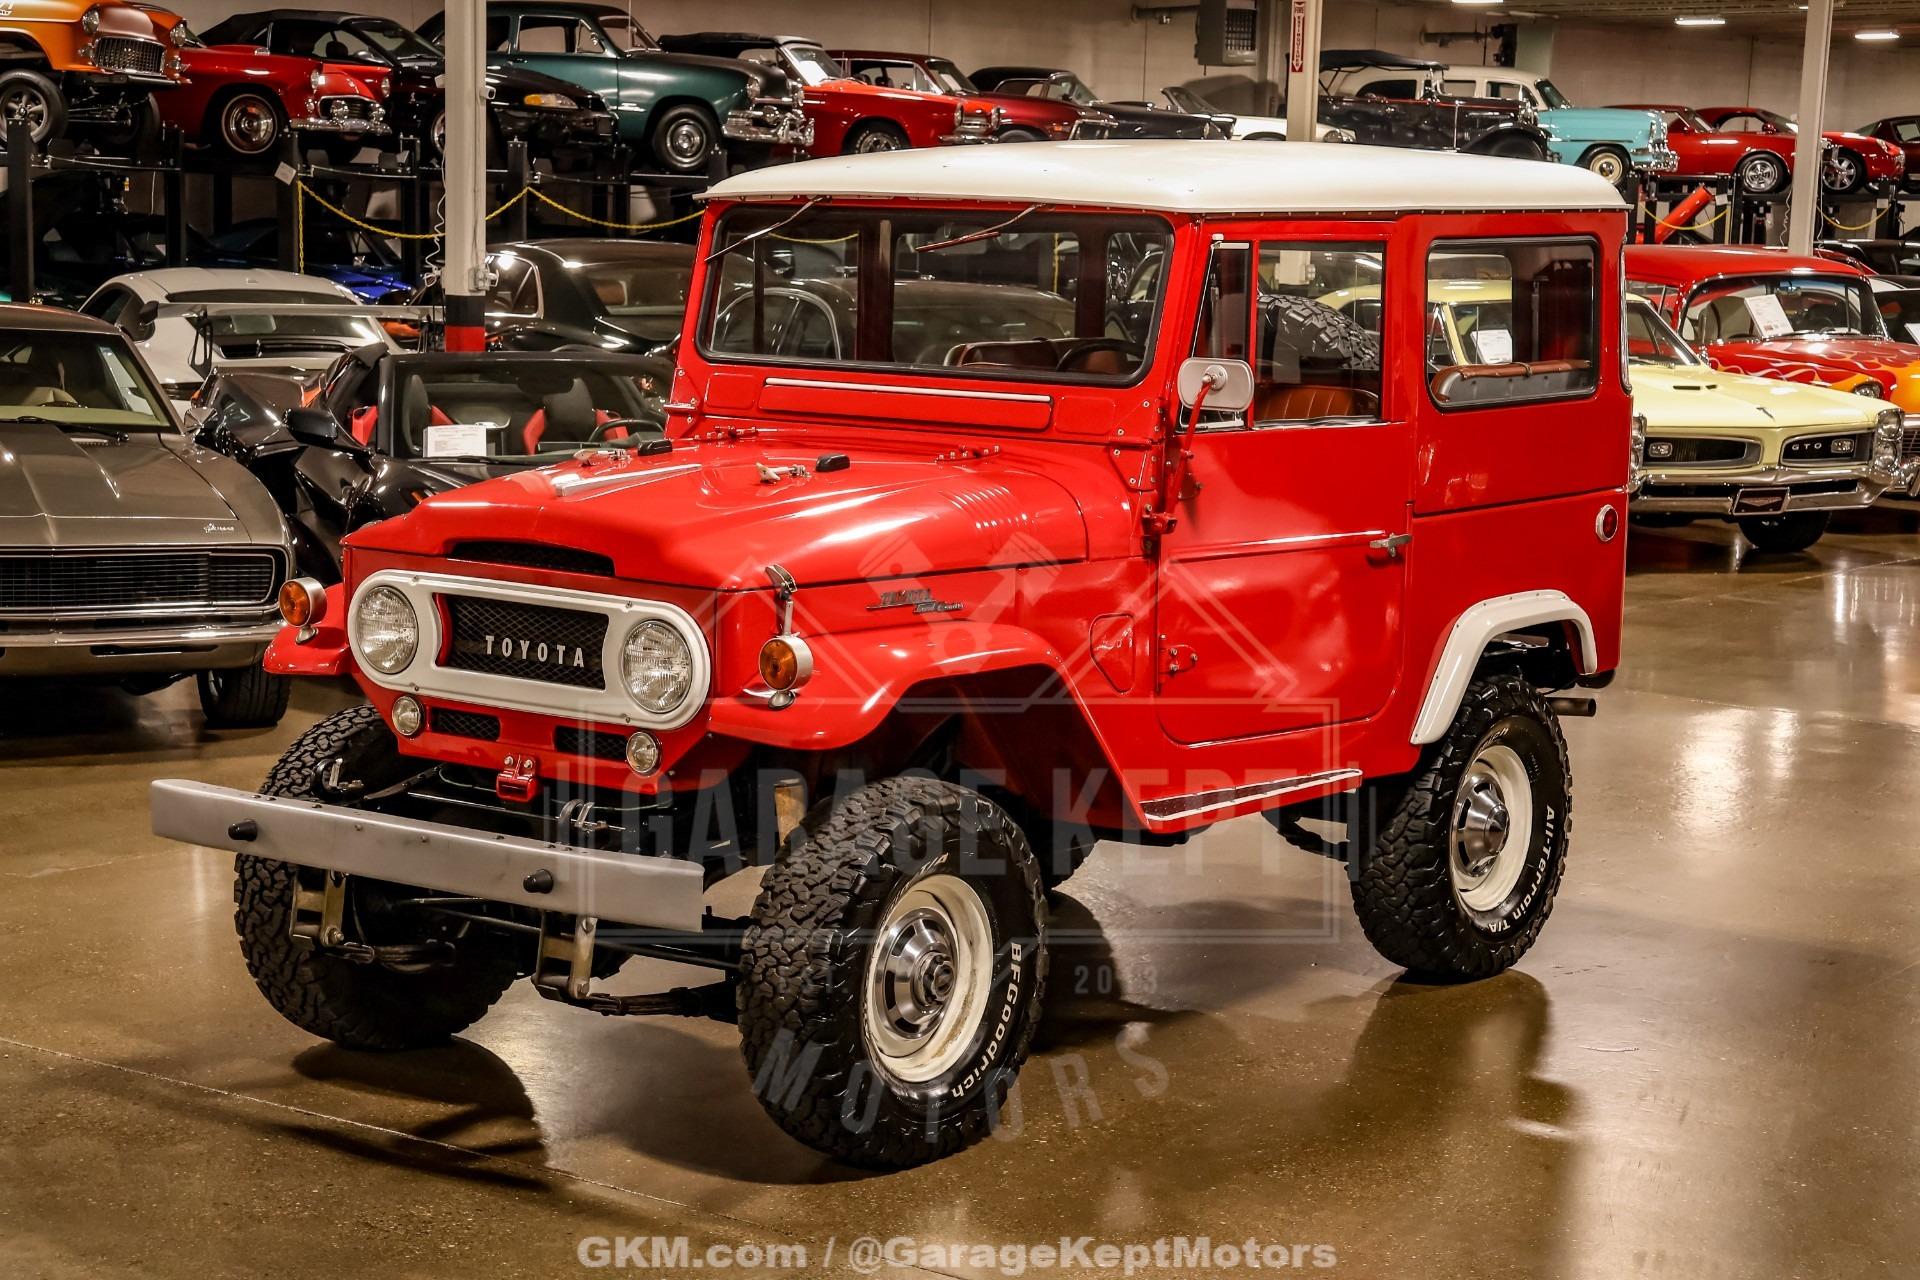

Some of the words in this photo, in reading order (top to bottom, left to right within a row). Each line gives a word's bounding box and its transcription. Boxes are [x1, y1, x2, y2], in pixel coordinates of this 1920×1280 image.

[1791, 442, 1822, 451] GTO
[485, 635, 585, 668] TOYOTA
[1512, 804, 1555, 921] All-Terrain
[1488, 920, 1511, 934] T/A
[951, 941, 1022, 1100] BFGoodrich
